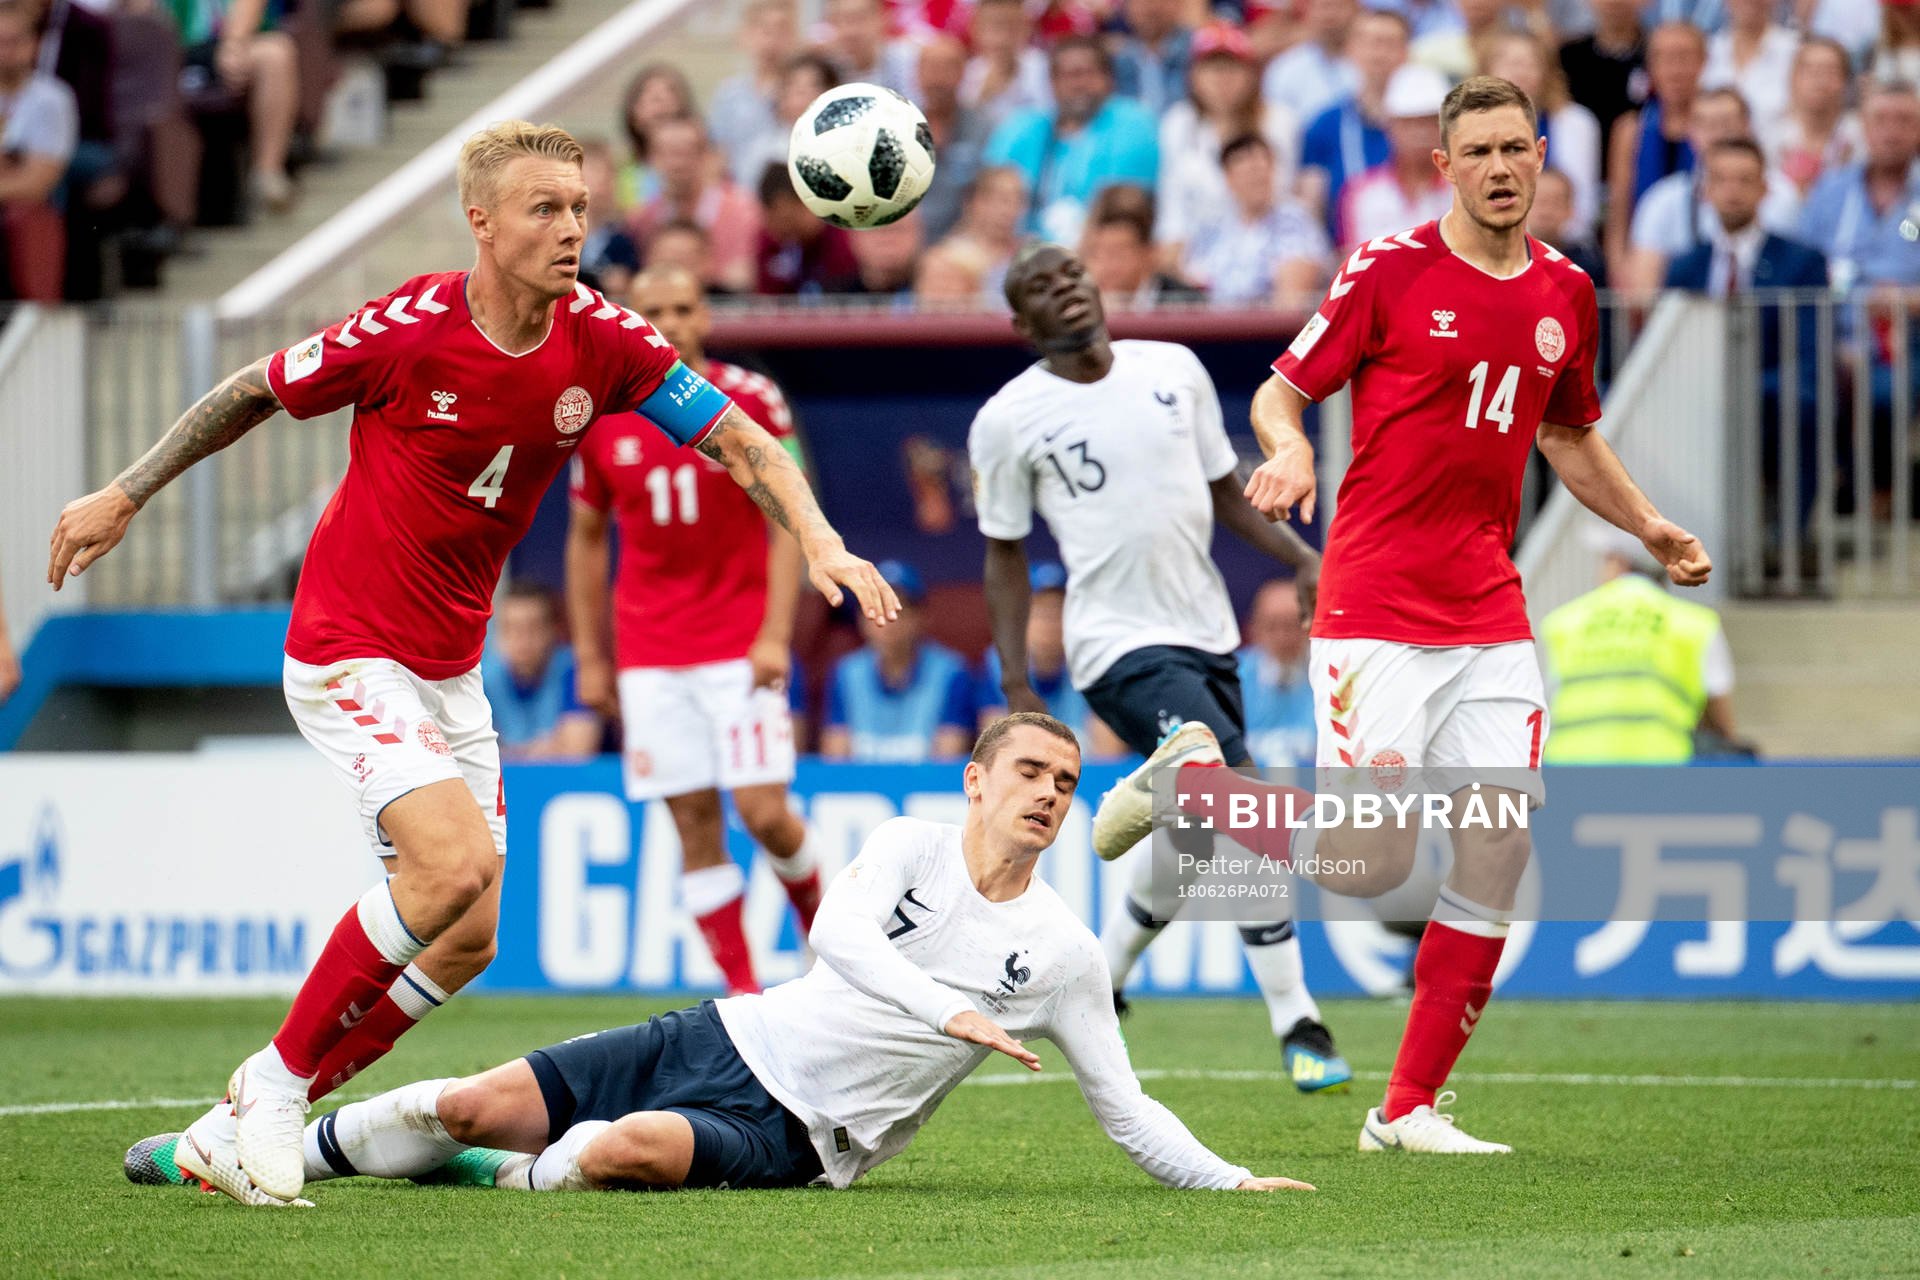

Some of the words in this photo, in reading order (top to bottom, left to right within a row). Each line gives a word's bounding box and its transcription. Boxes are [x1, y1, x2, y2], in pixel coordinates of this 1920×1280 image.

[1465, 360, 1521, 434] 14
[467, 444, 514, 508] 4
[645, 463, 699, 526] 11
[1048, 440, 1106, 498] 13
[1573, 806, 1920, 980] 万达
[75, 914, 306, 972] GAZPROM
